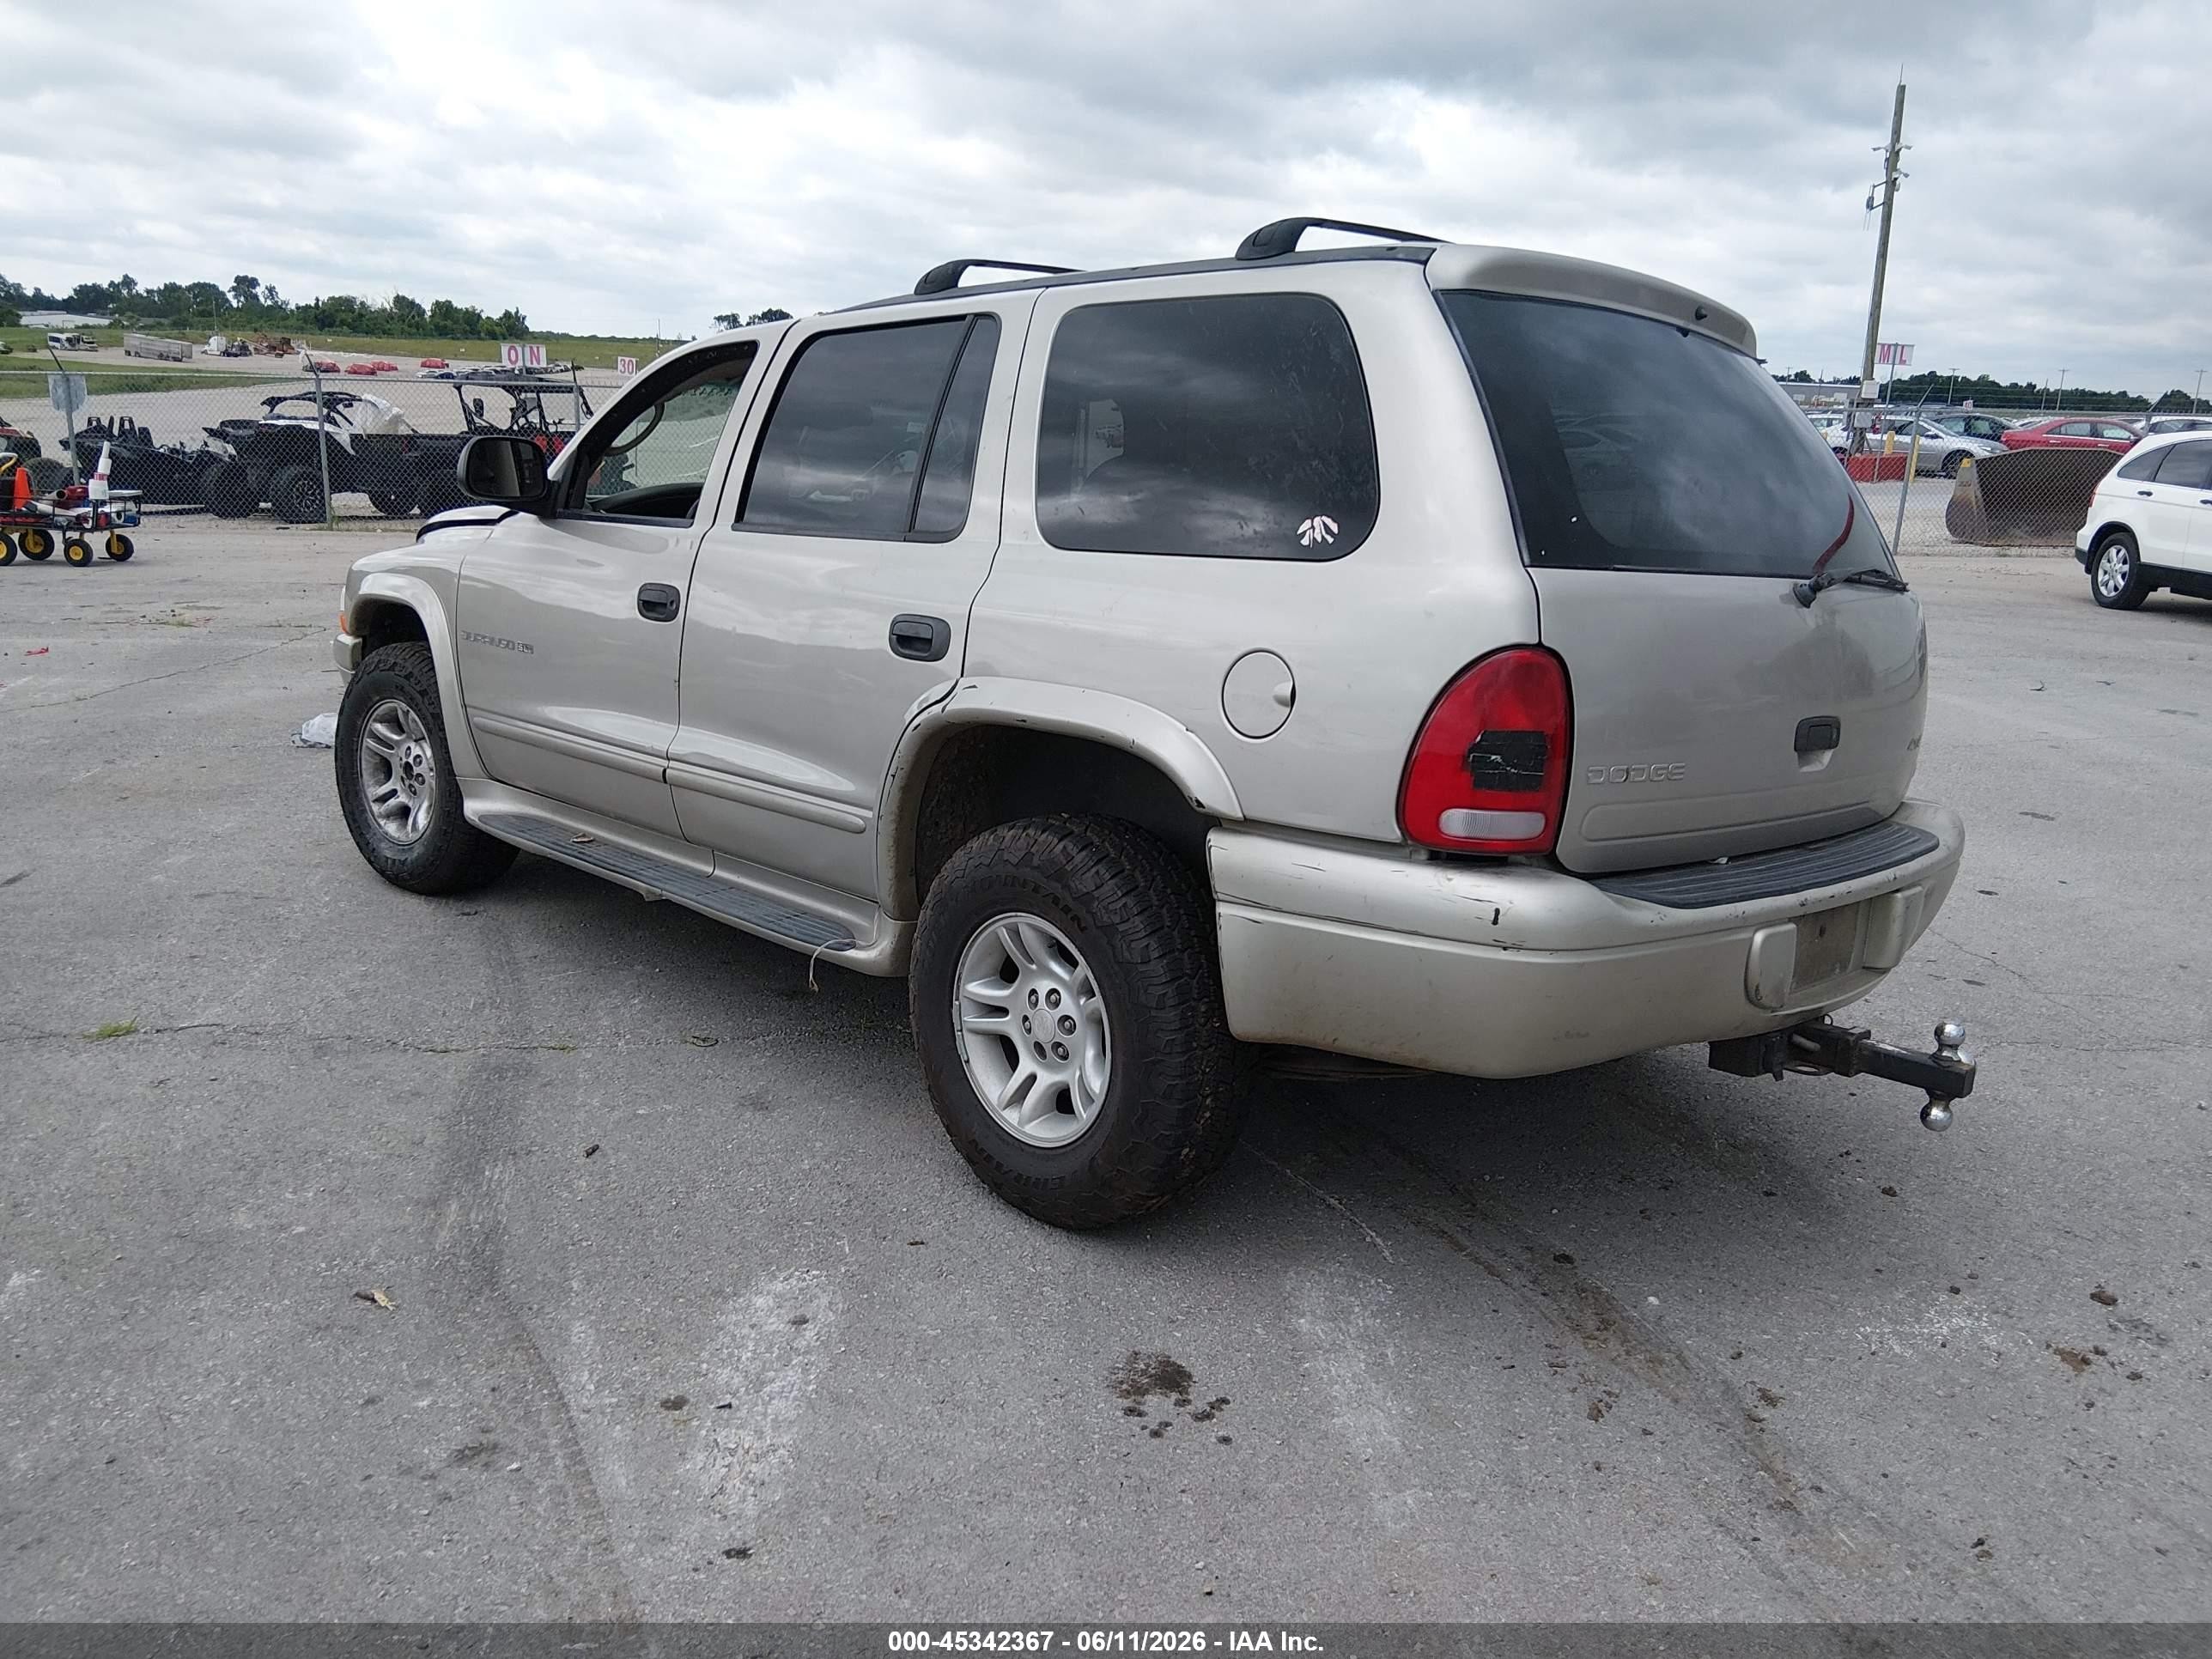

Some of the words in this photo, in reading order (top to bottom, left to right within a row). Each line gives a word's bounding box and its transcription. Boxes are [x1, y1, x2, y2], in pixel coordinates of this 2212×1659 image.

[507, 345, 519, 366] O
[529, 345, 541, 366] N
[1878, 343, 1891, 363] M
[1899, 344, 1907, 365] L
[619, 358, 635, 374] 30
[1587, 763, 1685, 784] DODGE
